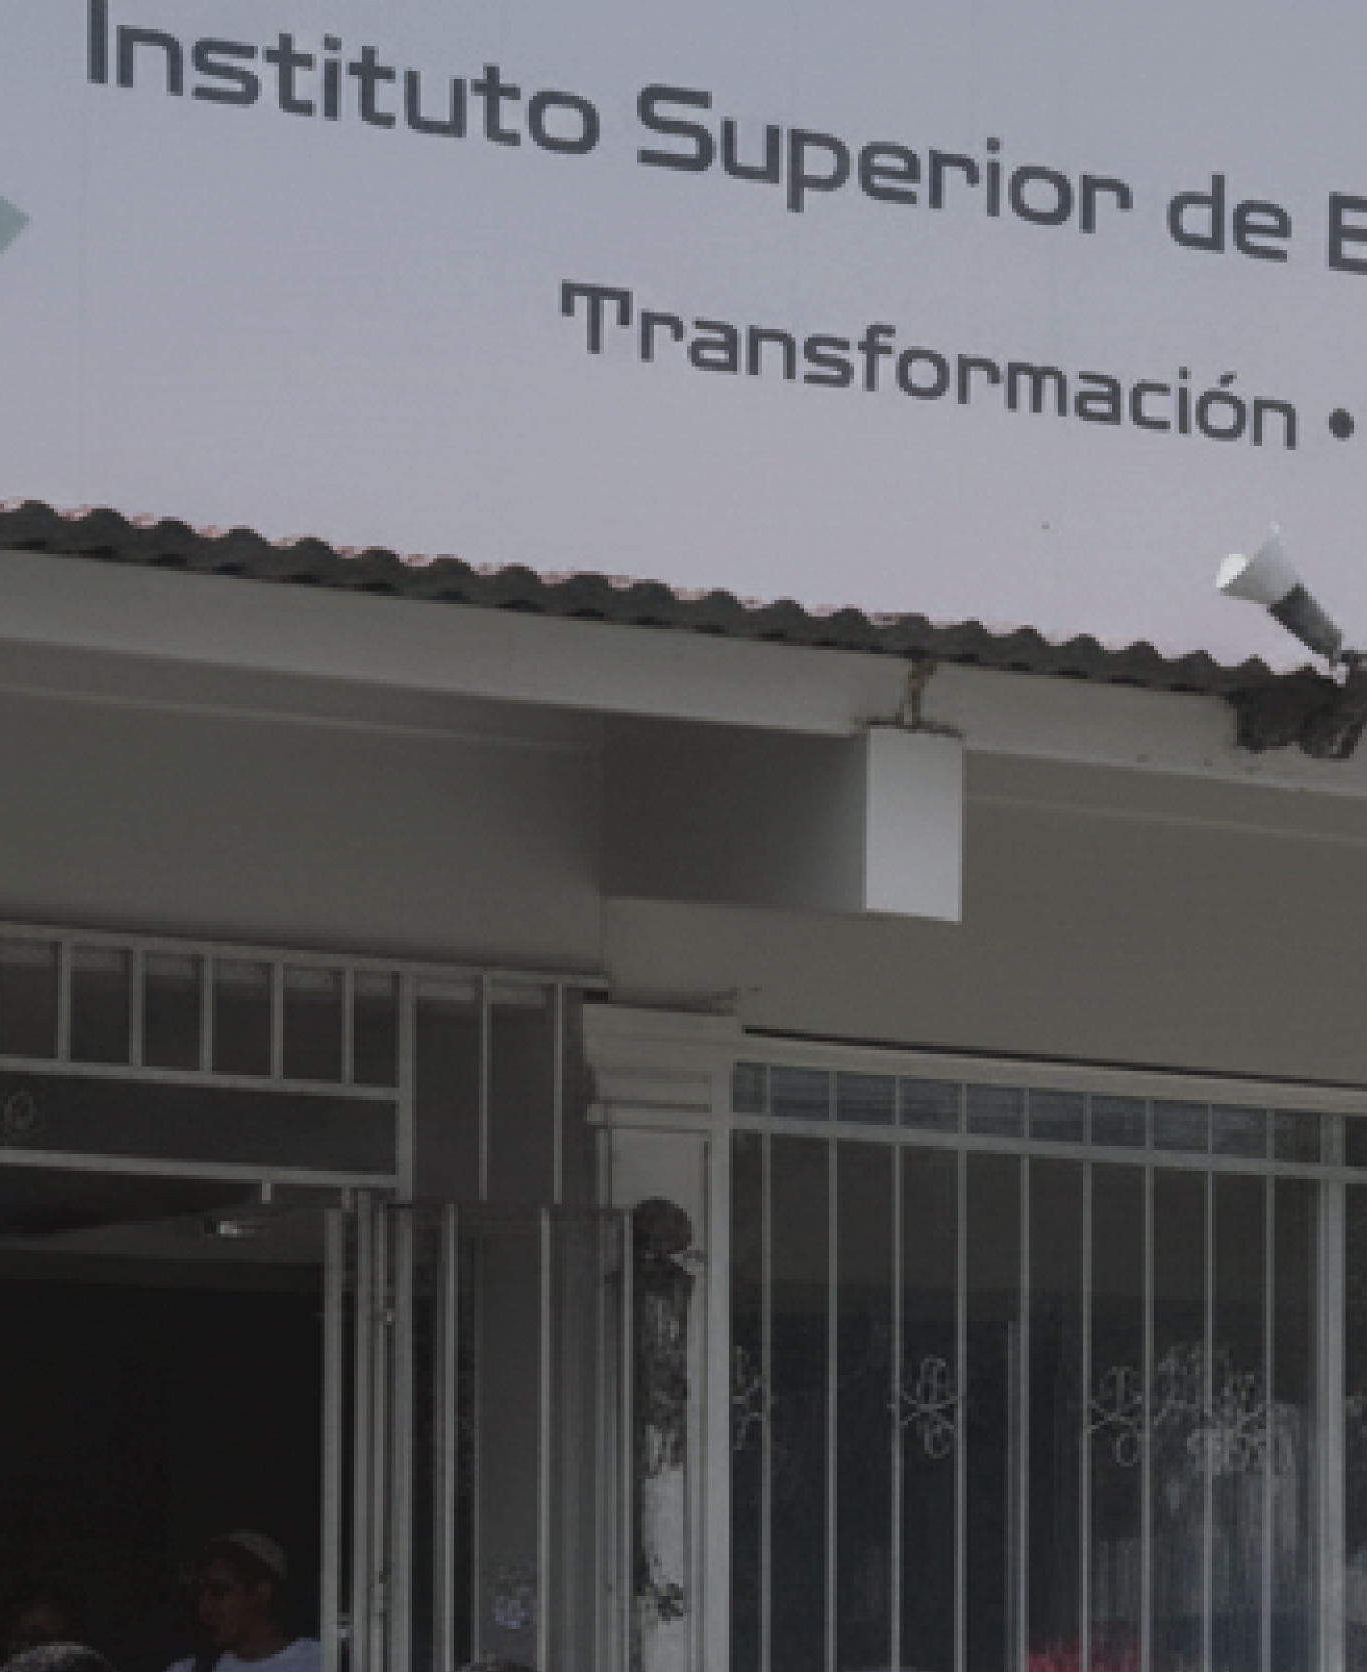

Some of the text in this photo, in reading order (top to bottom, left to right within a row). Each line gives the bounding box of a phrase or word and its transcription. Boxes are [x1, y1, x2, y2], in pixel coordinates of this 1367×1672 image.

[86, 0, 601, 155] Instituto
[636, 83, 1134, 234] Superior
[1166, 174, 1293, 263] de
[561, 278, 1297, 451] Transformación
